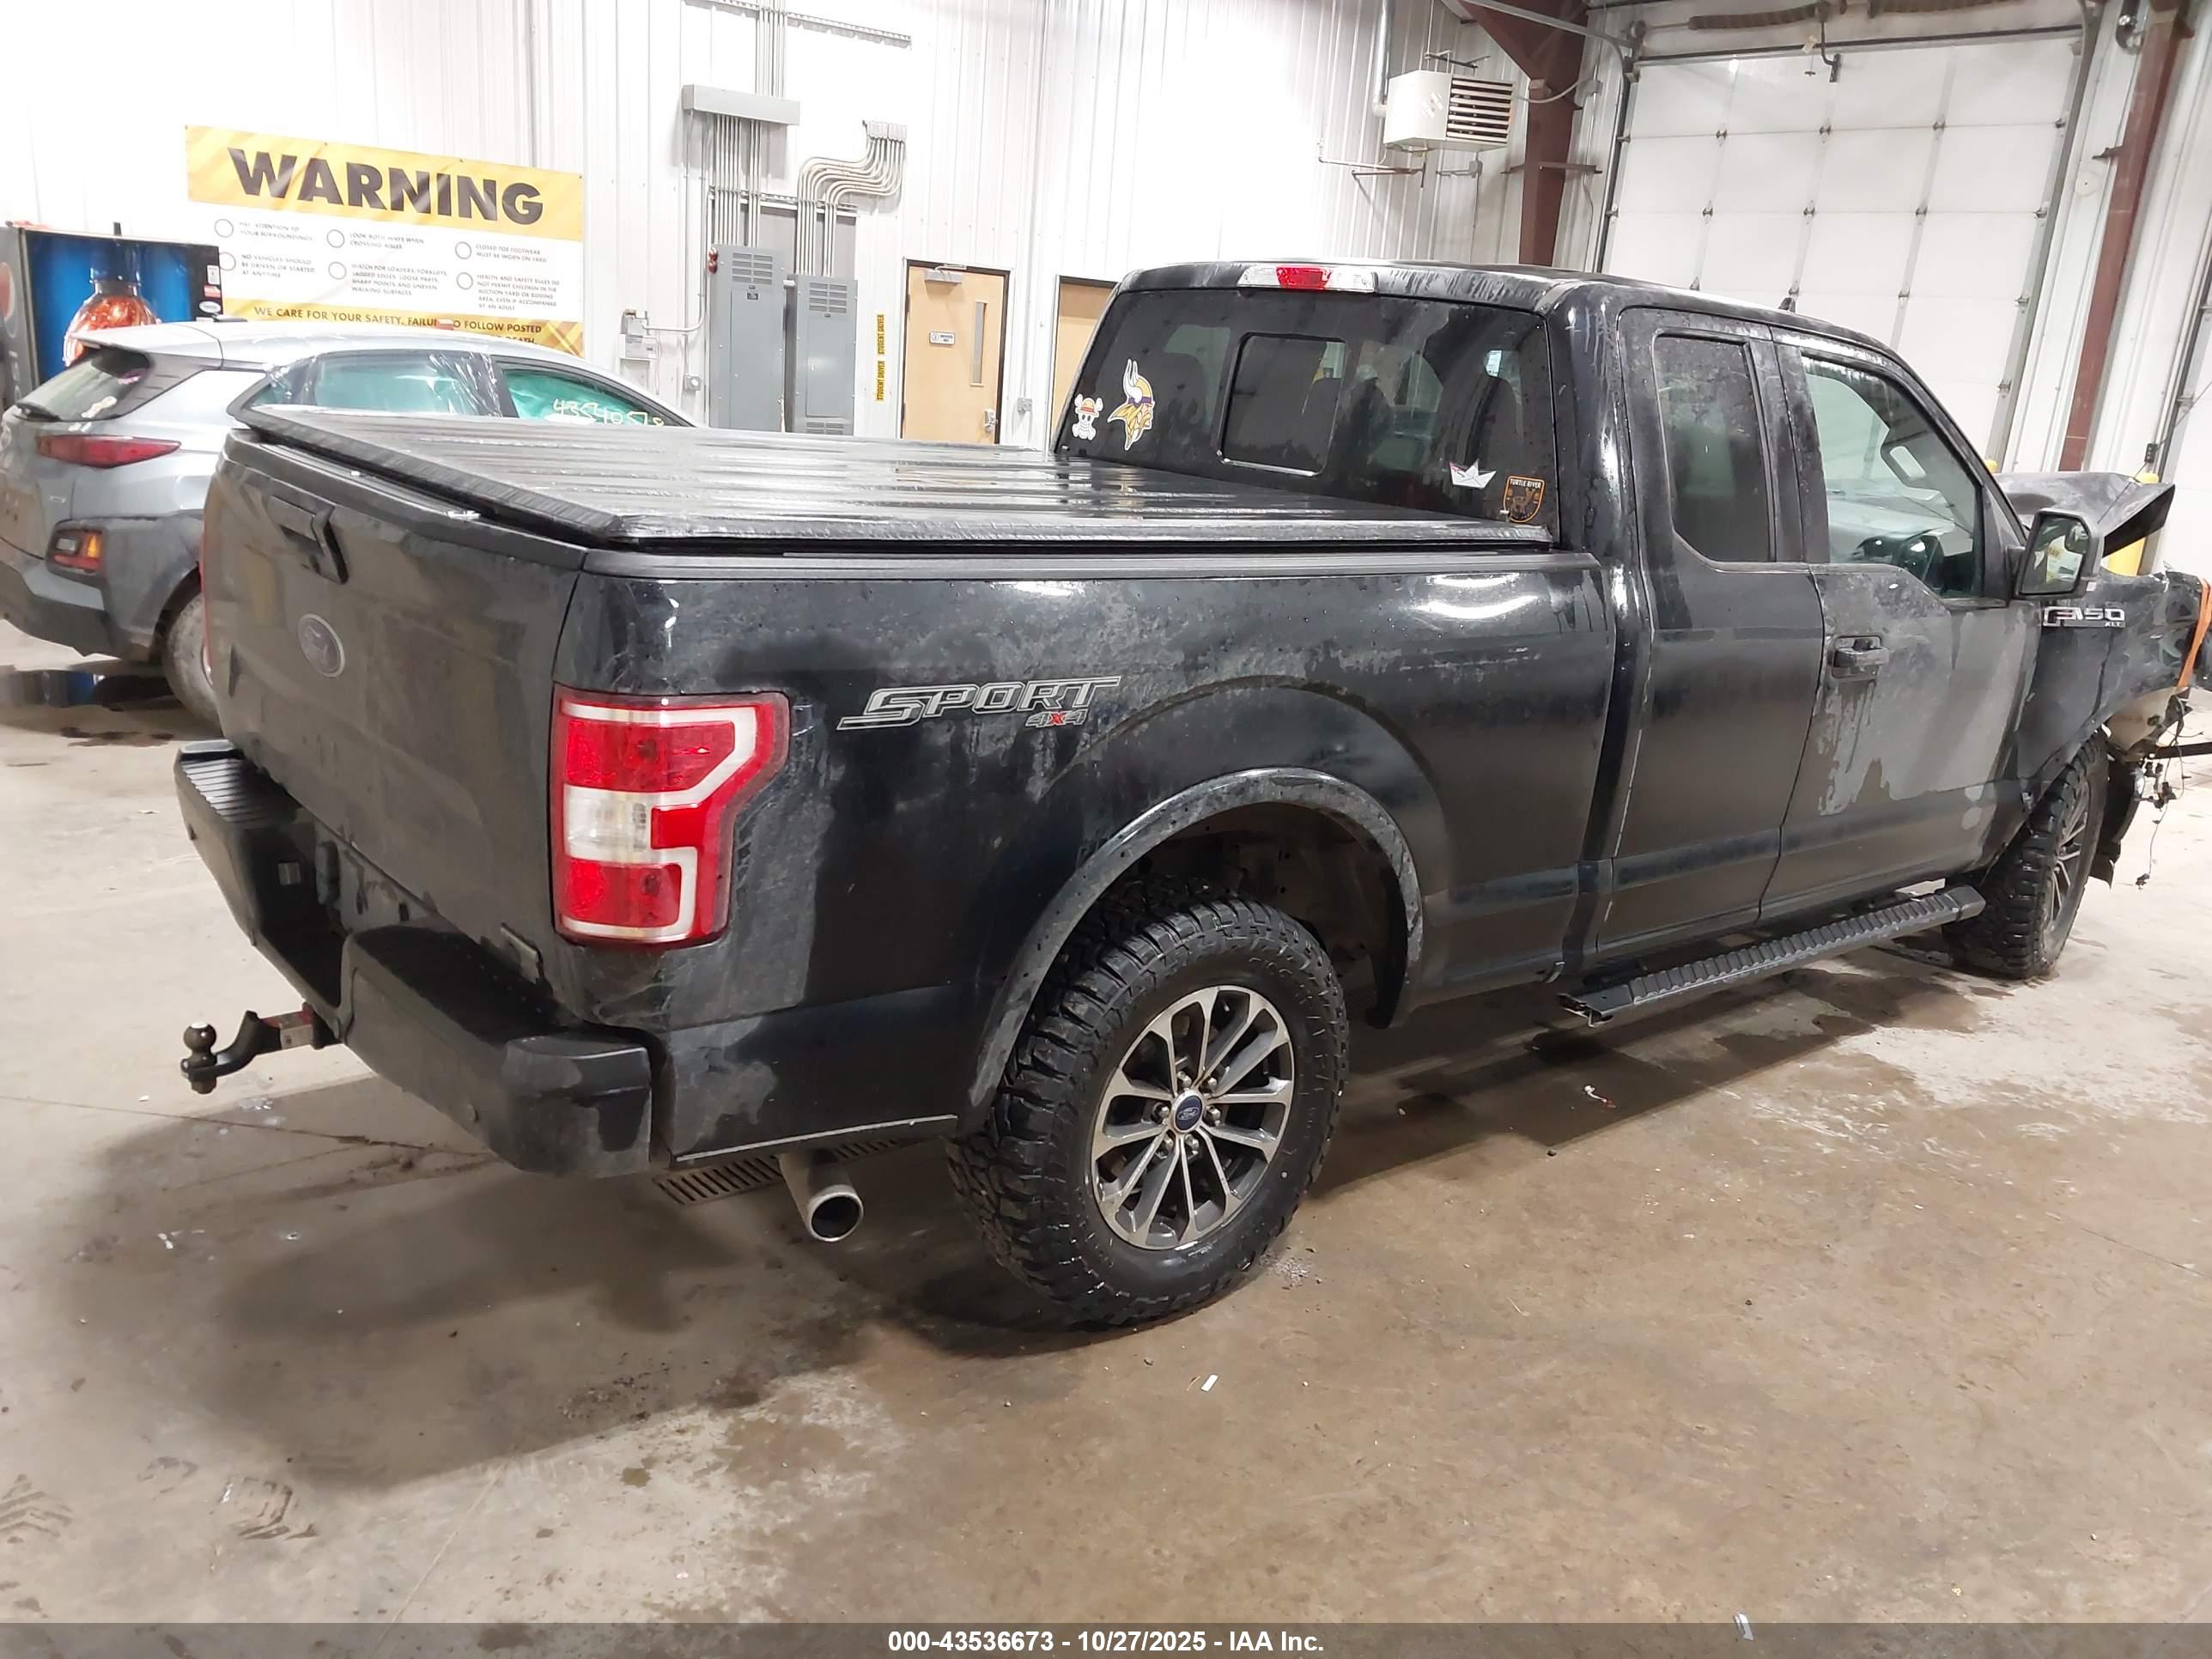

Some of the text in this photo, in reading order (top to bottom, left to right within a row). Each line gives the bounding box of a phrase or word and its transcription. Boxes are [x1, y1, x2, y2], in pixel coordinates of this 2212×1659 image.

[227, 148, 544, 225] WARNING
[254, 307, 272, 316] WE
[276, 308, 303, 318] CARE
[307, 310, 328, 320] FOR
[331, 311, 362, 322] YOUR
[464, 320, 504, 331] FOLLOW
[507, 323, 542, 334] POSTED
[836, 676, 1121, 730] SPORT
